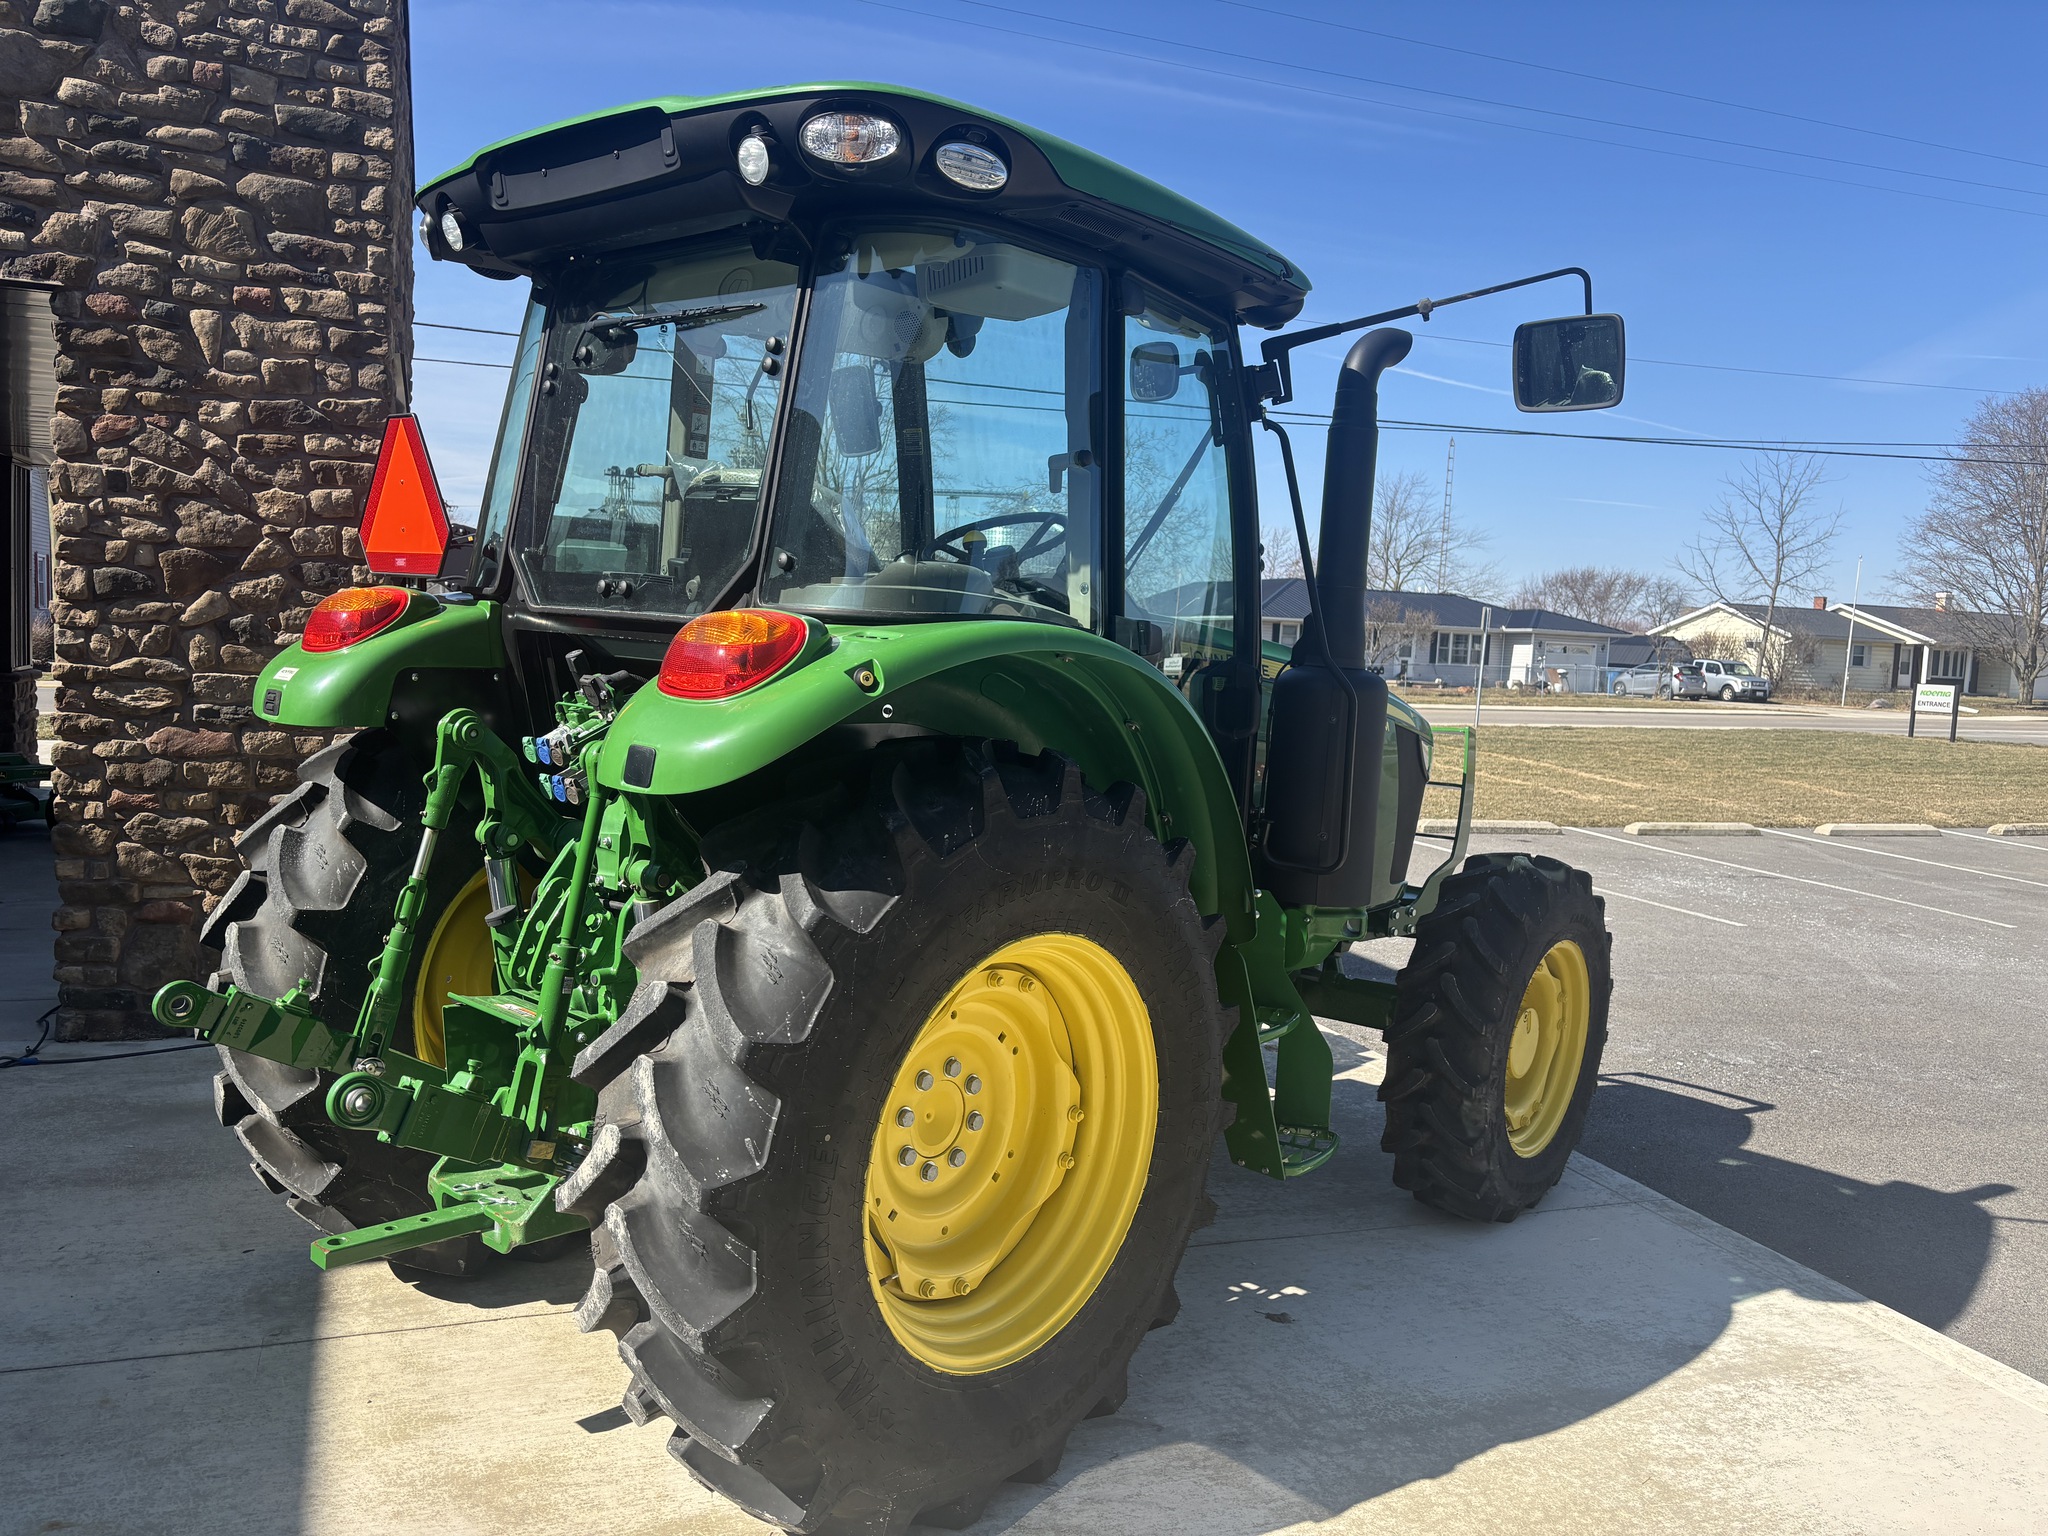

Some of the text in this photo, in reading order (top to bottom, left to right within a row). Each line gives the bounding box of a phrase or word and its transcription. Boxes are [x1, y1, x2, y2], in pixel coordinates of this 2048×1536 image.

[1918, 700, 1951, 708] ENTRANCE
[958, 868, 1104, 937] FARMPRO
[798, 1144, 880, 1411] ALLIANCE
